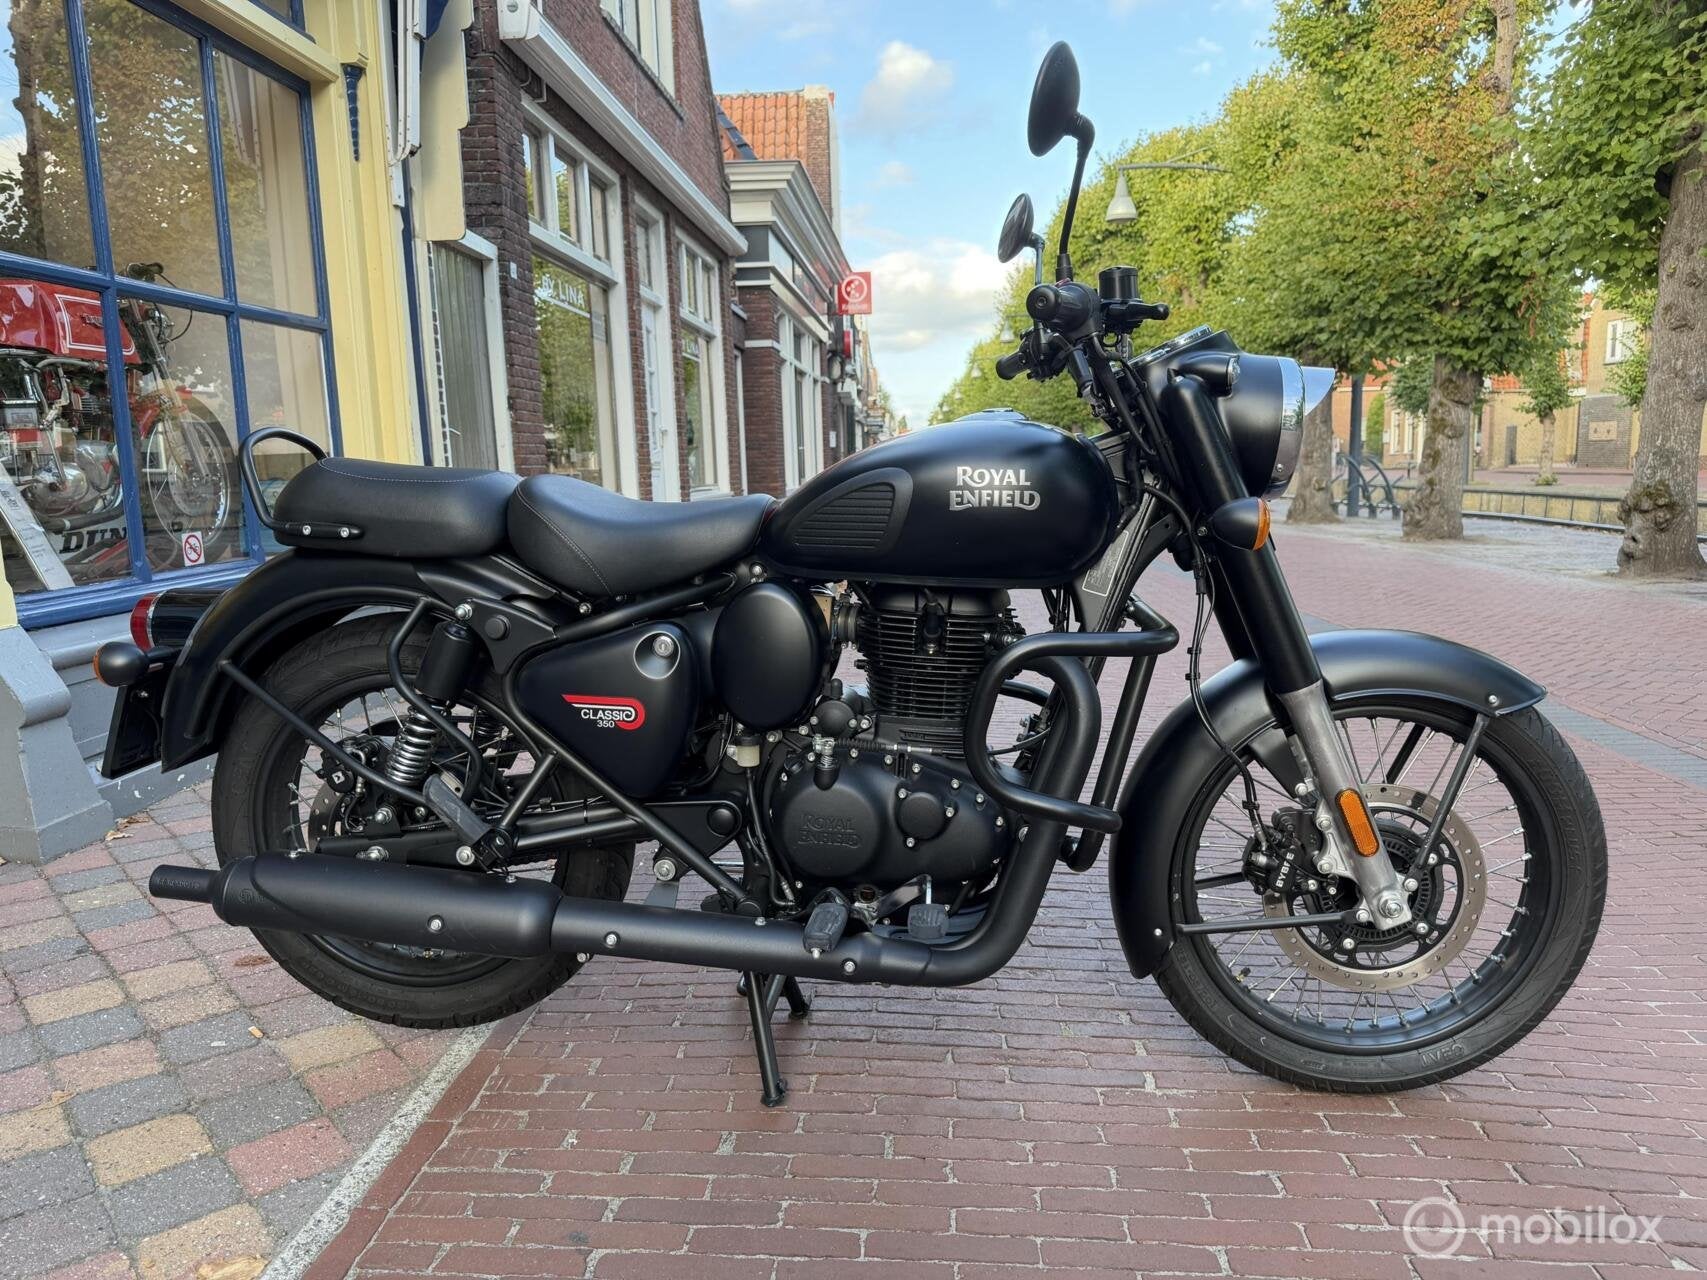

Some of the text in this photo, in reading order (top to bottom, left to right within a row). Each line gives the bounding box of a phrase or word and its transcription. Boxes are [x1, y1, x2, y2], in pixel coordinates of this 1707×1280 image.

[558, 279, 585, 309] LINA
[956, 466, 1031, 487] ROYAL
[949, 490, 1041, 511] ENFIELD
[580, 708, 635, 722] CLASSIC
[597, 719, 615, 728] 350
